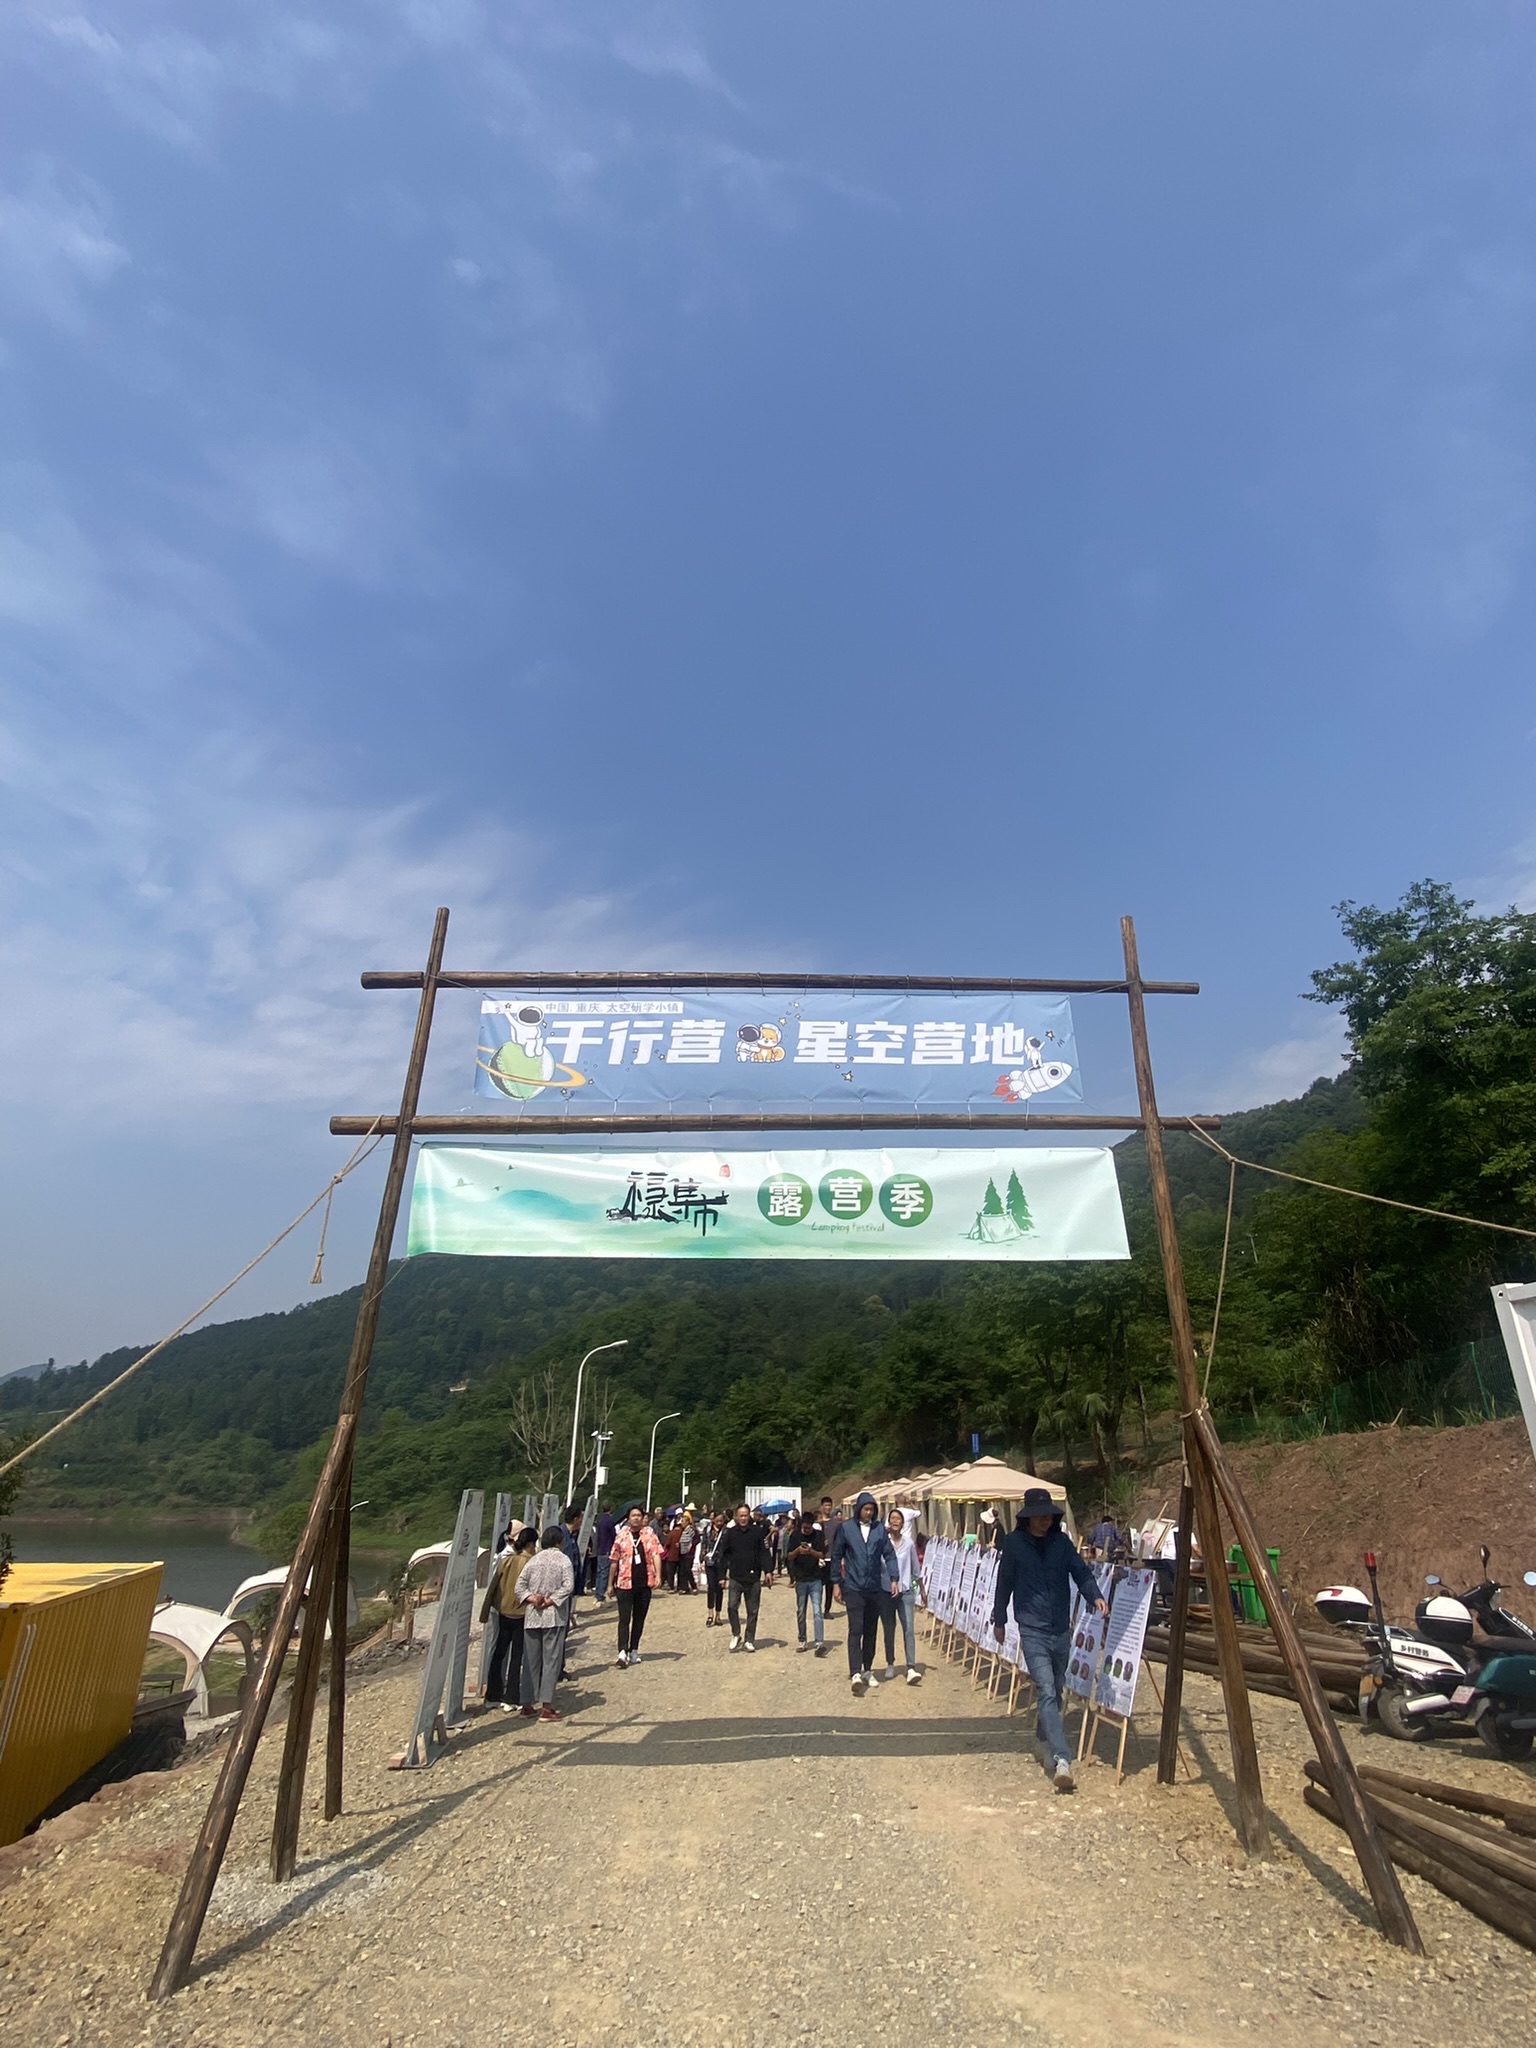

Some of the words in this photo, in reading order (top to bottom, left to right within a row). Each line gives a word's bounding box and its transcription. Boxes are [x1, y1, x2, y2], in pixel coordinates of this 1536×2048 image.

[793, 1020, 1026, 1066] 星空营地
[767, 1176, 926, 1220] 露营季
